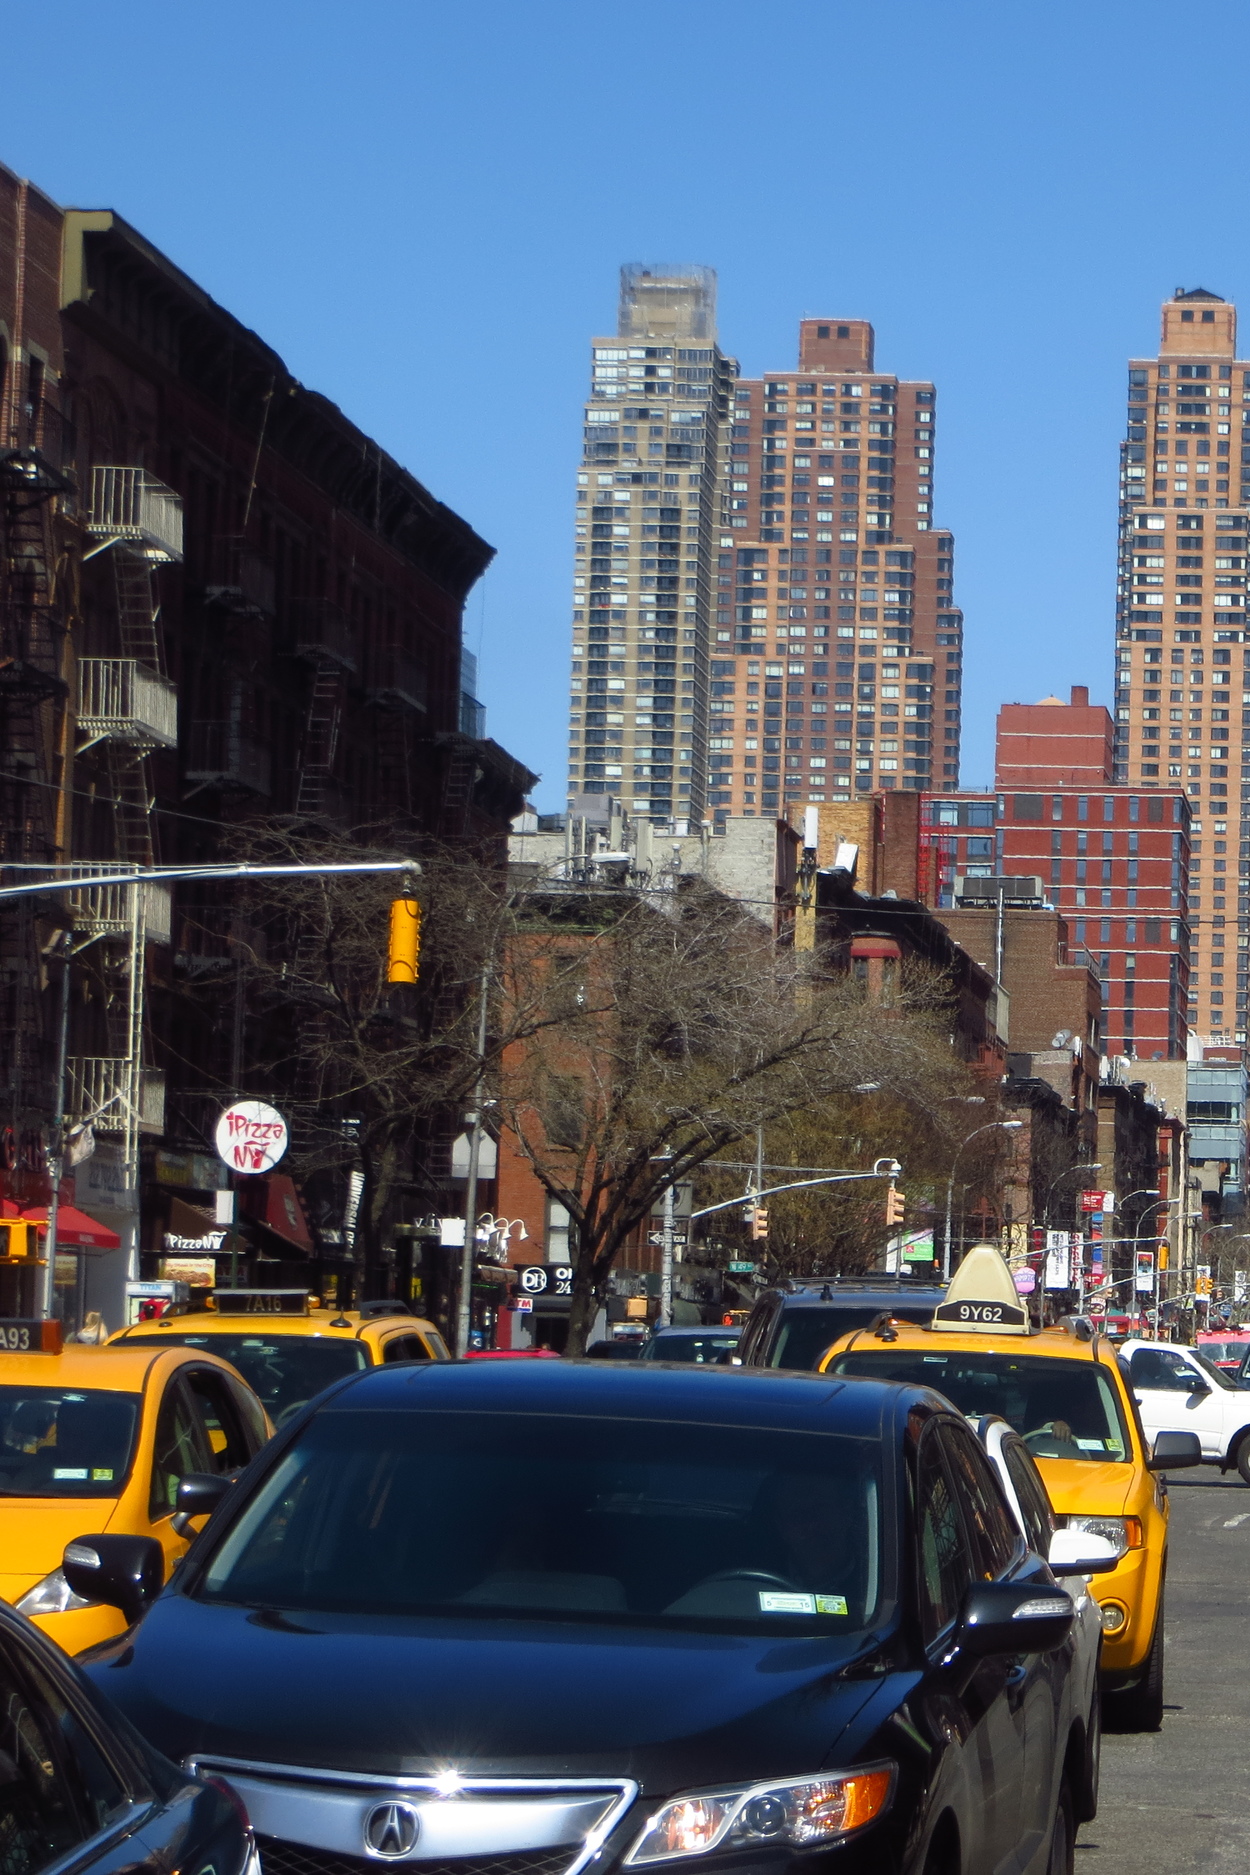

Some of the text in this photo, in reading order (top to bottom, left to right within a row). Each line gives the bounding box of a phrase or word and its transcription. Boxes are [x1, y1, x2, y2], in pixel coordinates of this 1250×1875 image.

[226, 1111, 284, 1139] iPizza
[344, 1171, 366, 1228] UNIVERSAL
[244, 1295, 282, 1311] 7A16
[509, 1299, 531, 1308] ATM
[960, 1305, 1003, 1321] 9Y62
